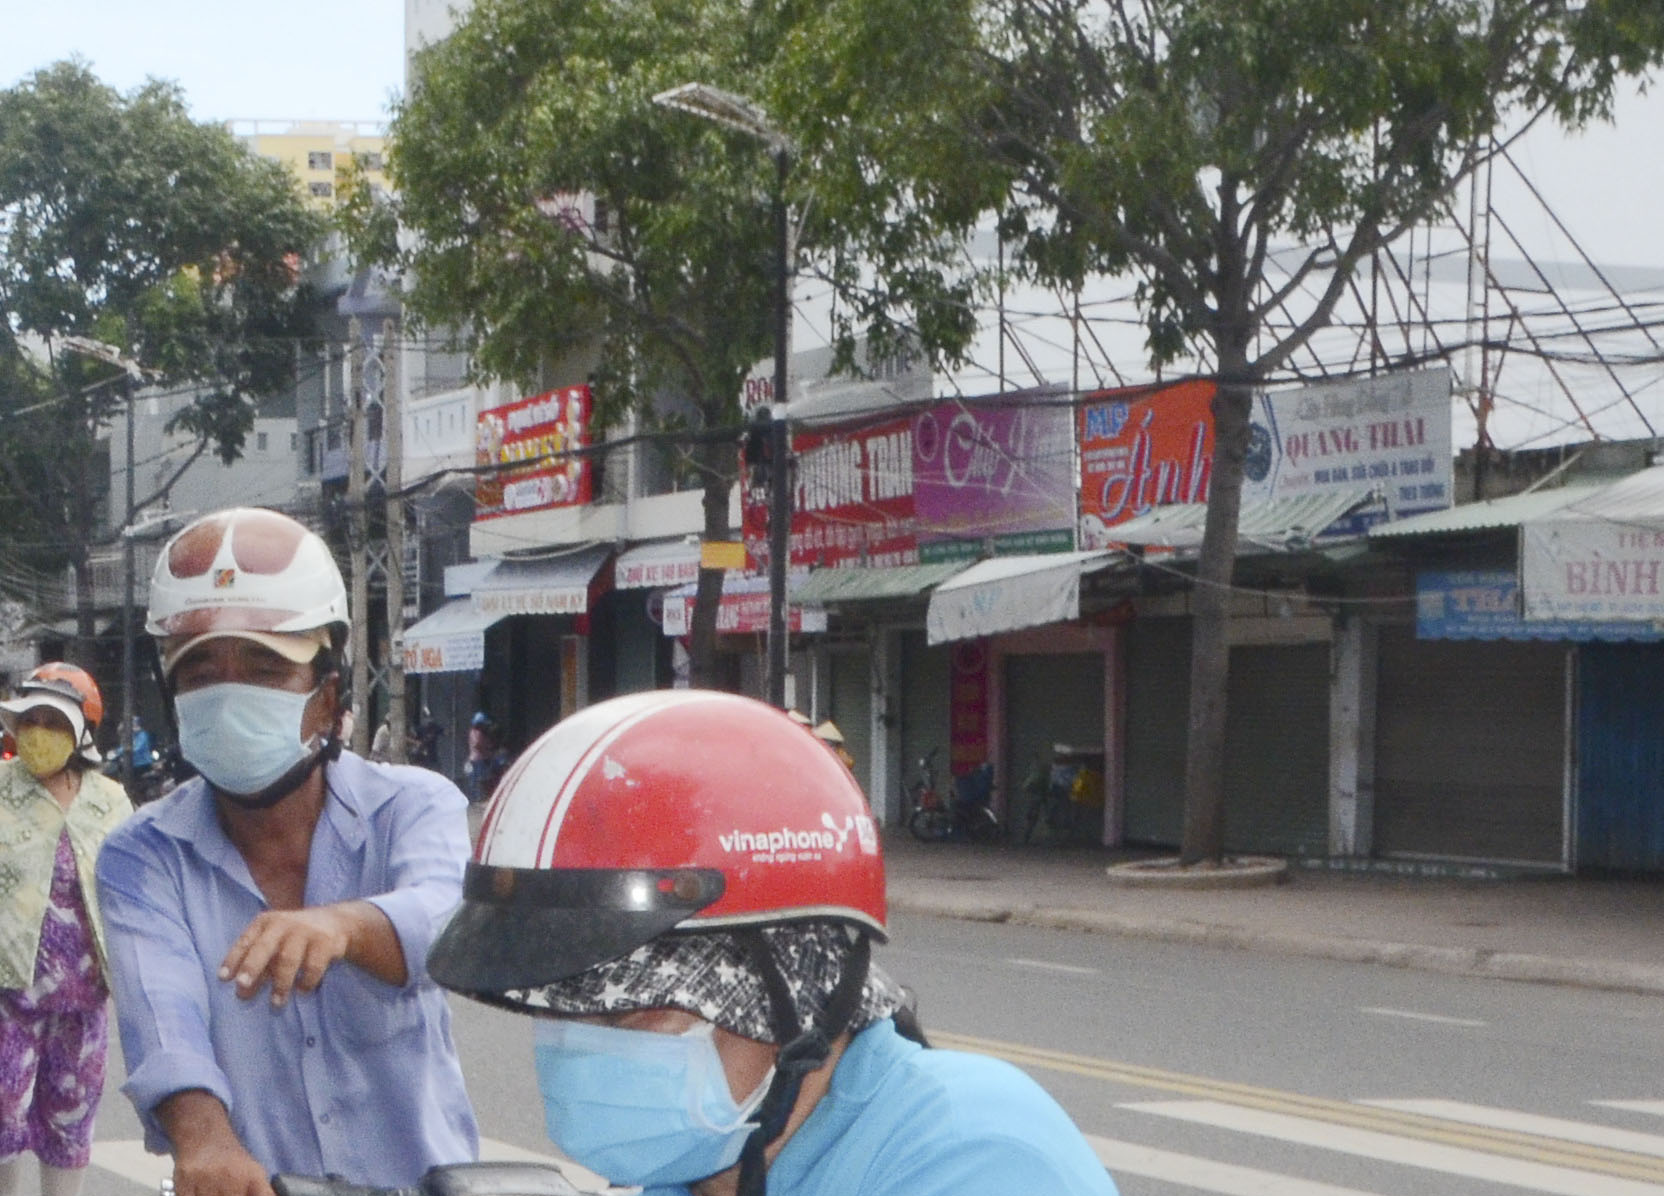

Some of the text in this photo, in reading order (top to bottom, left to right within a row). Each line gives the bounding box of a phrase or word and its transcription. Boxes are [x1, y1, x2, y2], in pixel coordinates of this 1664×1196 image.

[1287, 426, 1359, 468] QUANG
[1567, 550, 1660, 595] BÌNH
[719, 827, 835, 853] vinaphone
